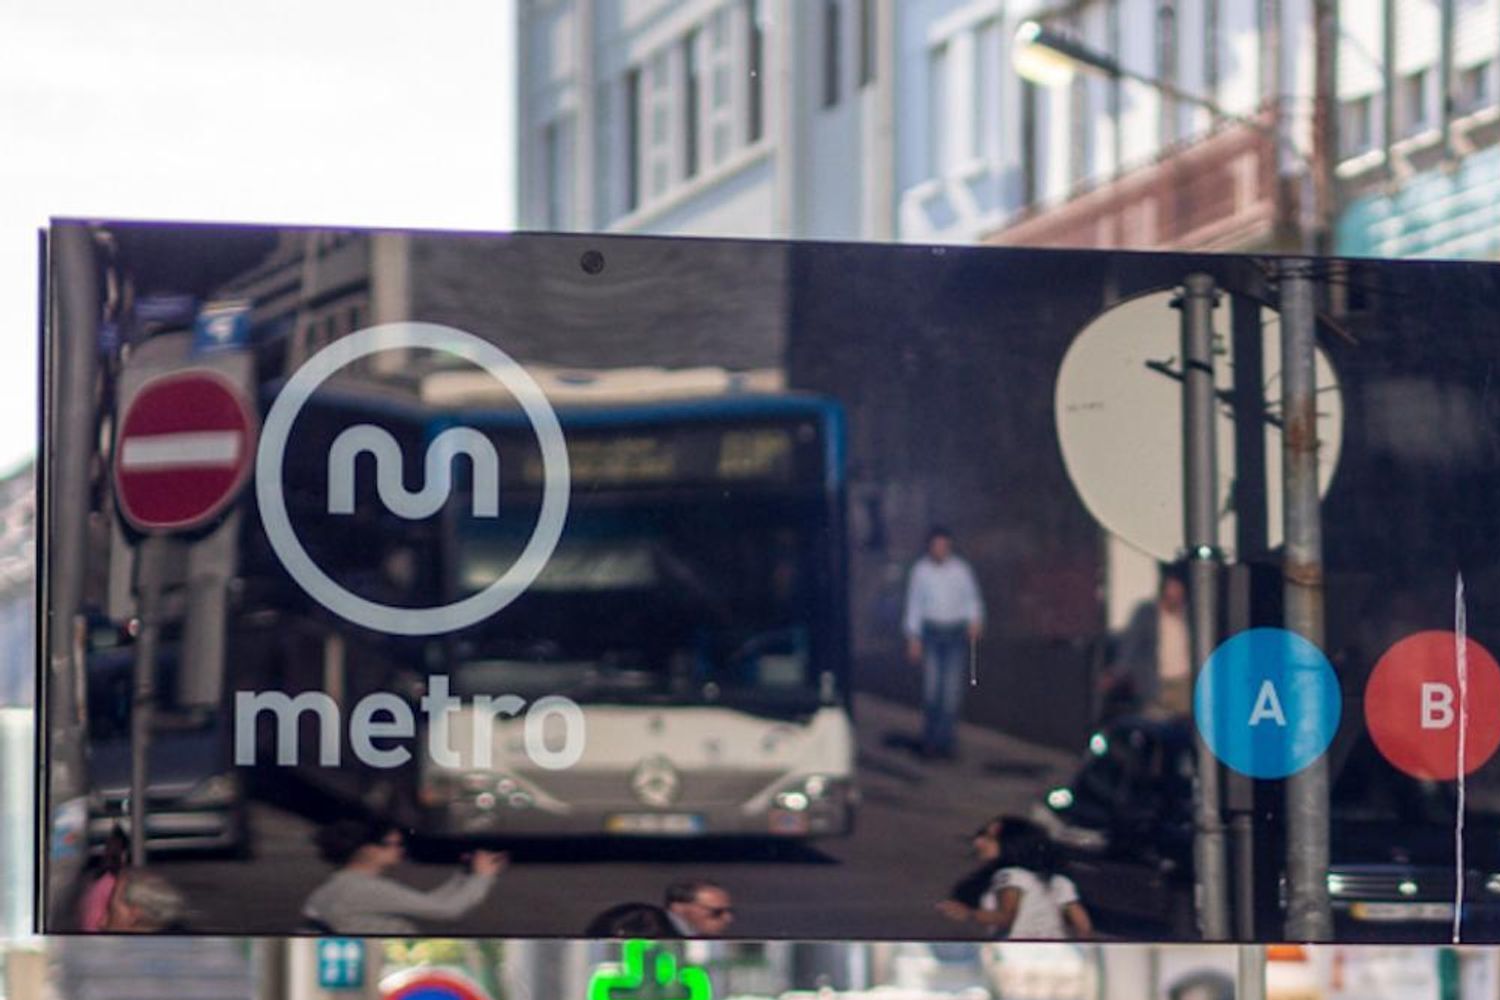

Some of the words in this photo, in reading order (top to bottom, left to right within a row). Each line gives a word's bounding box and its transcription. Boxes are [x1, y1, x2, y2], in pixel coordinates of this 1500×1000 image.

[235, 675, 586, 770] metro
[1248, 680, 1286, 726] A
[1420, 682, 1455, 729] B
